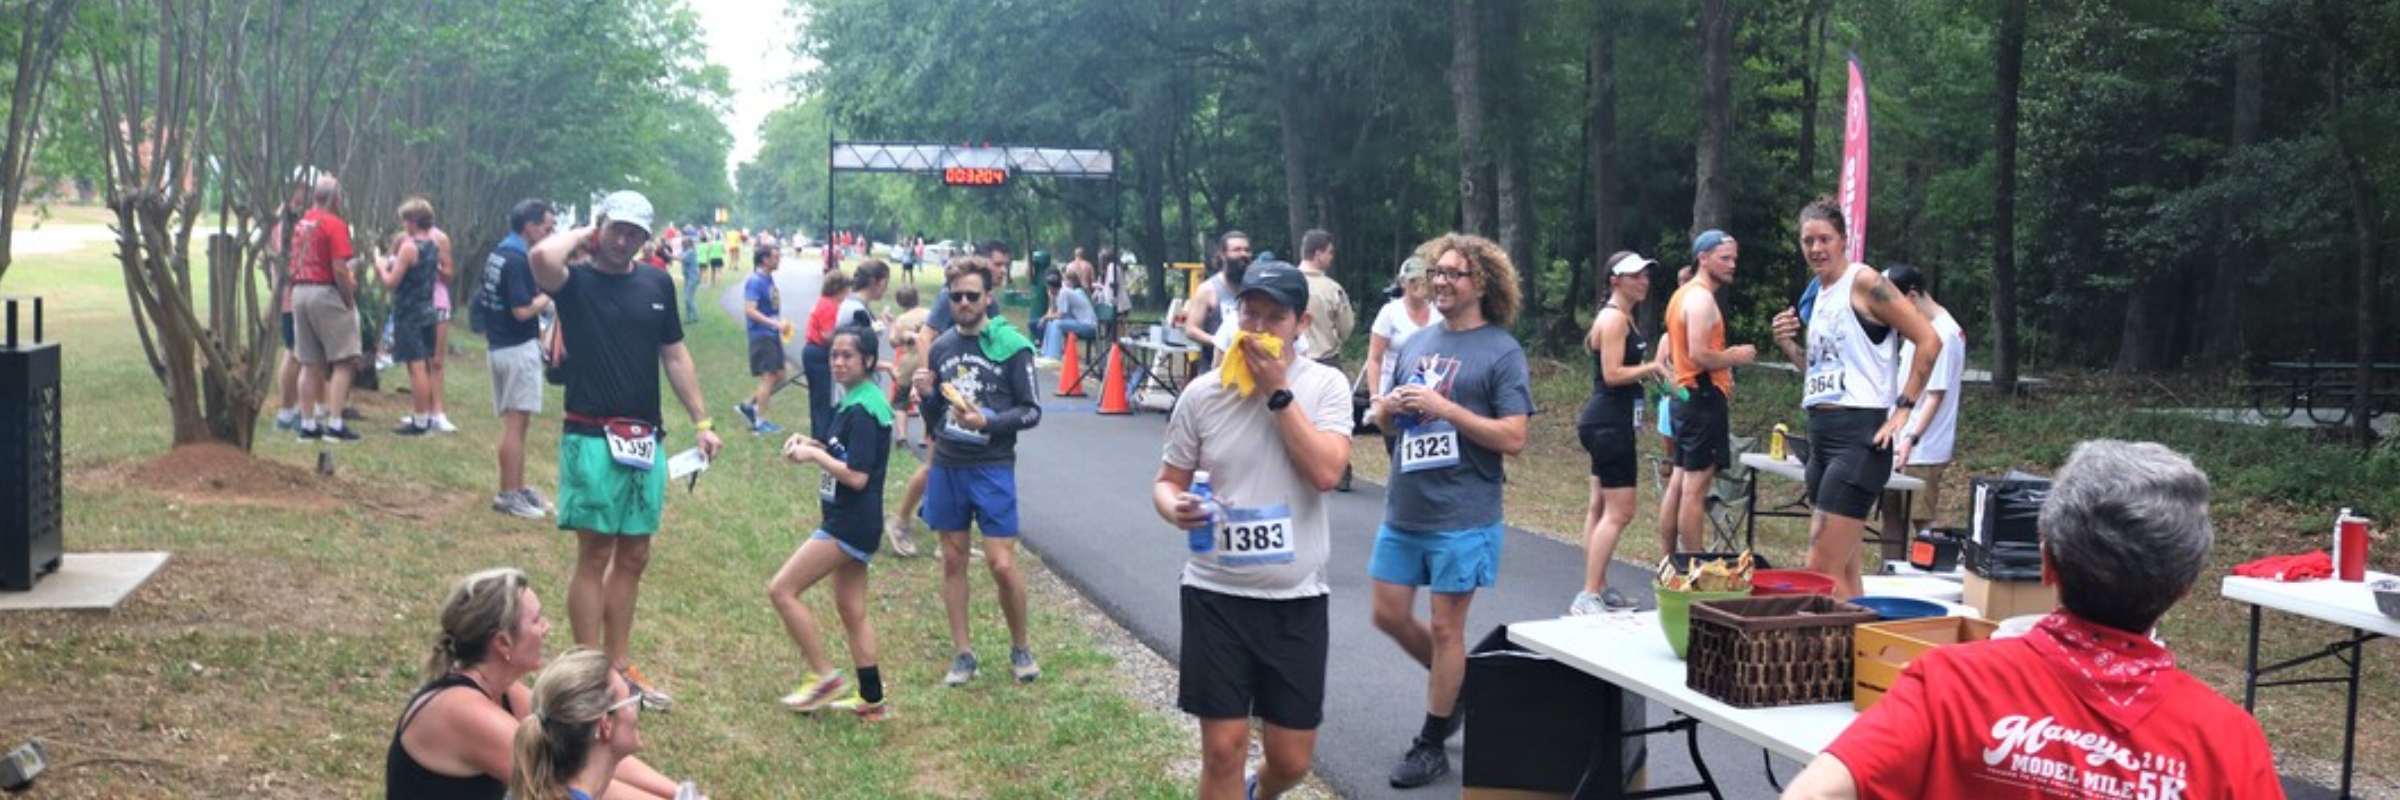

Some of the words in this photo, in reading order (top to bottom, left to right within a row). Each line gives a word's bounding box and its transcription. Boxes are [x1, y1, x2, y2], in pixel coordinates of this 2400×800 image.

[1405, 435, 1451, 461] 1323
[1222, 523, 1284, 551] 1383
[2010, 754, 2079, 785] MODEL
[2083, 770, 2136, 800] MILE
[2142, 751, 2186, 779] 2022
